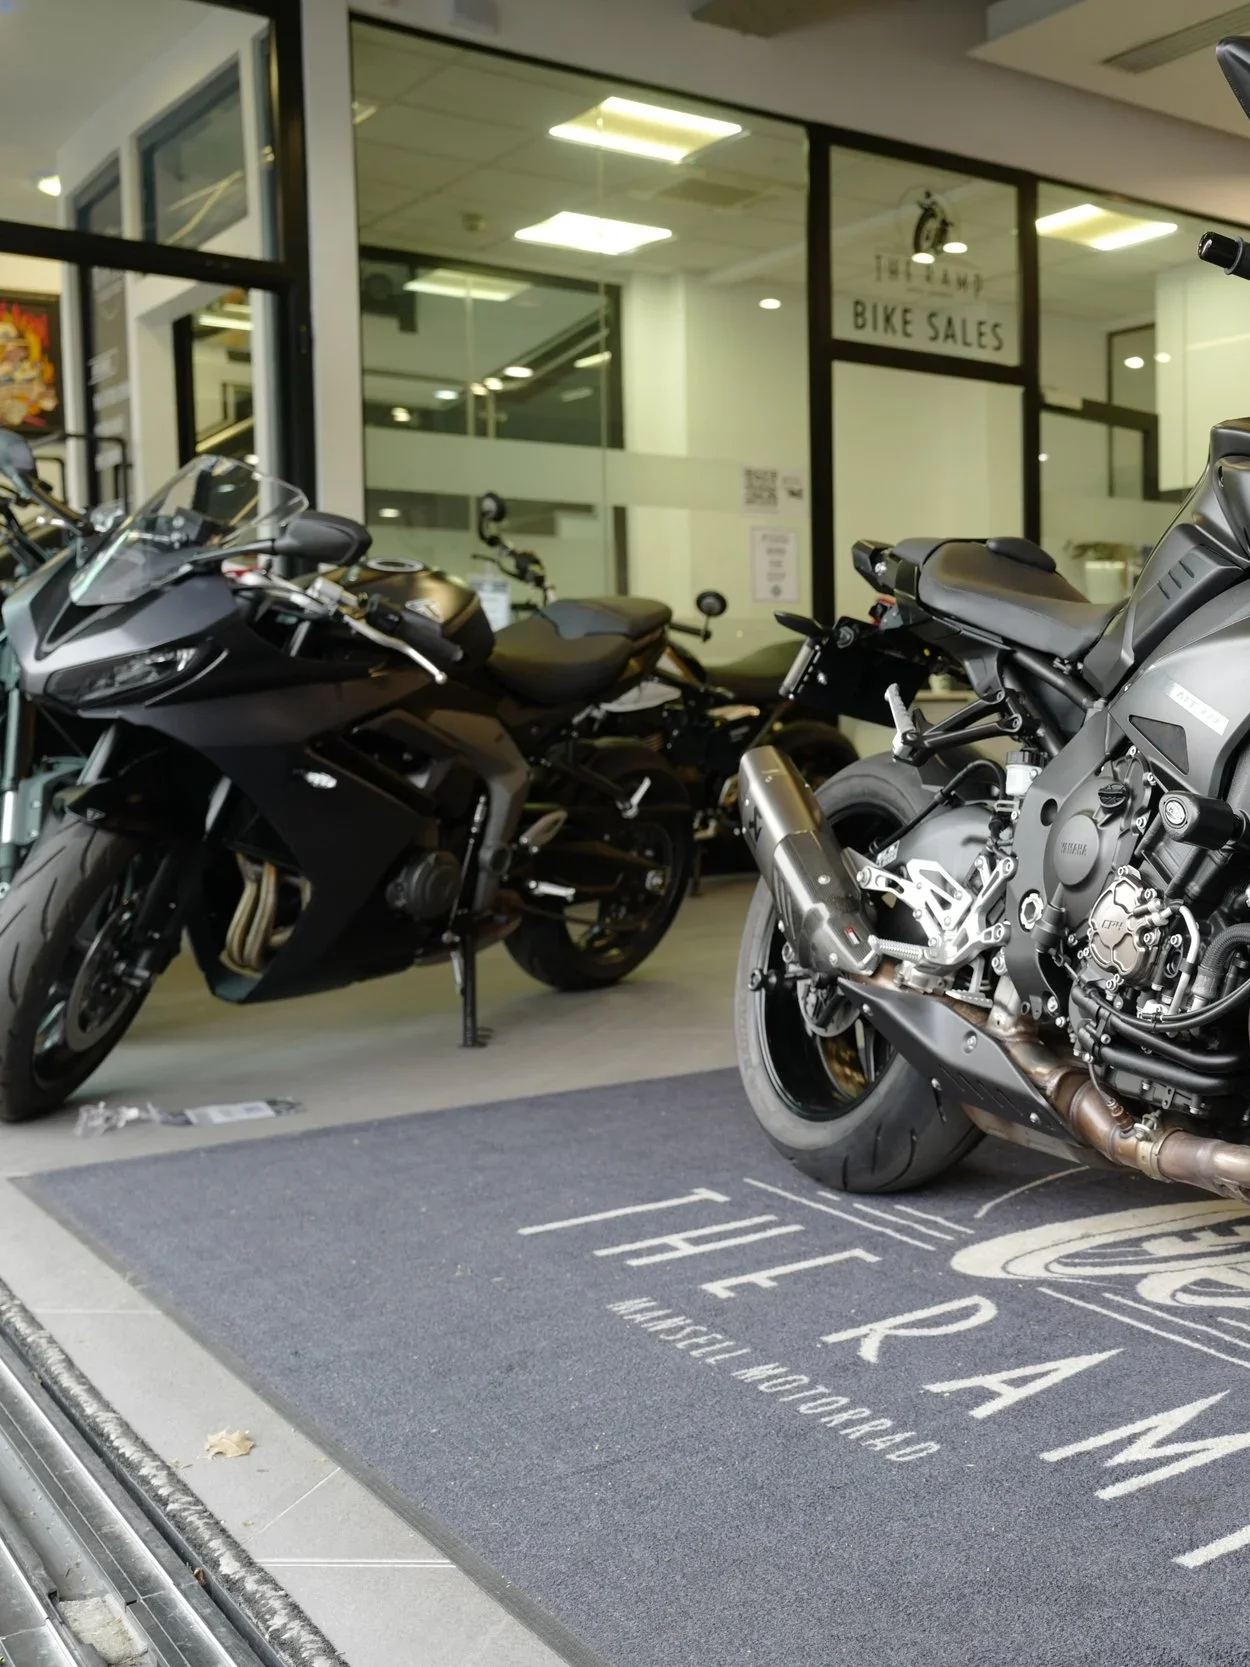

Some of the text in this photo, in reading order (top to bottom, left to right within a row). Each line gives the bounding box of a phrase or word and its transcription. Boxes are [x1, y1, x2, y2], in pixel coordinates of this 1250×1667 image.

[852, 300, 1004, 351] BIKE SALES
[516, 1187, 884, 1300] THE
[605, 1296, 943, 1463] MANSELL MOTORRAD
